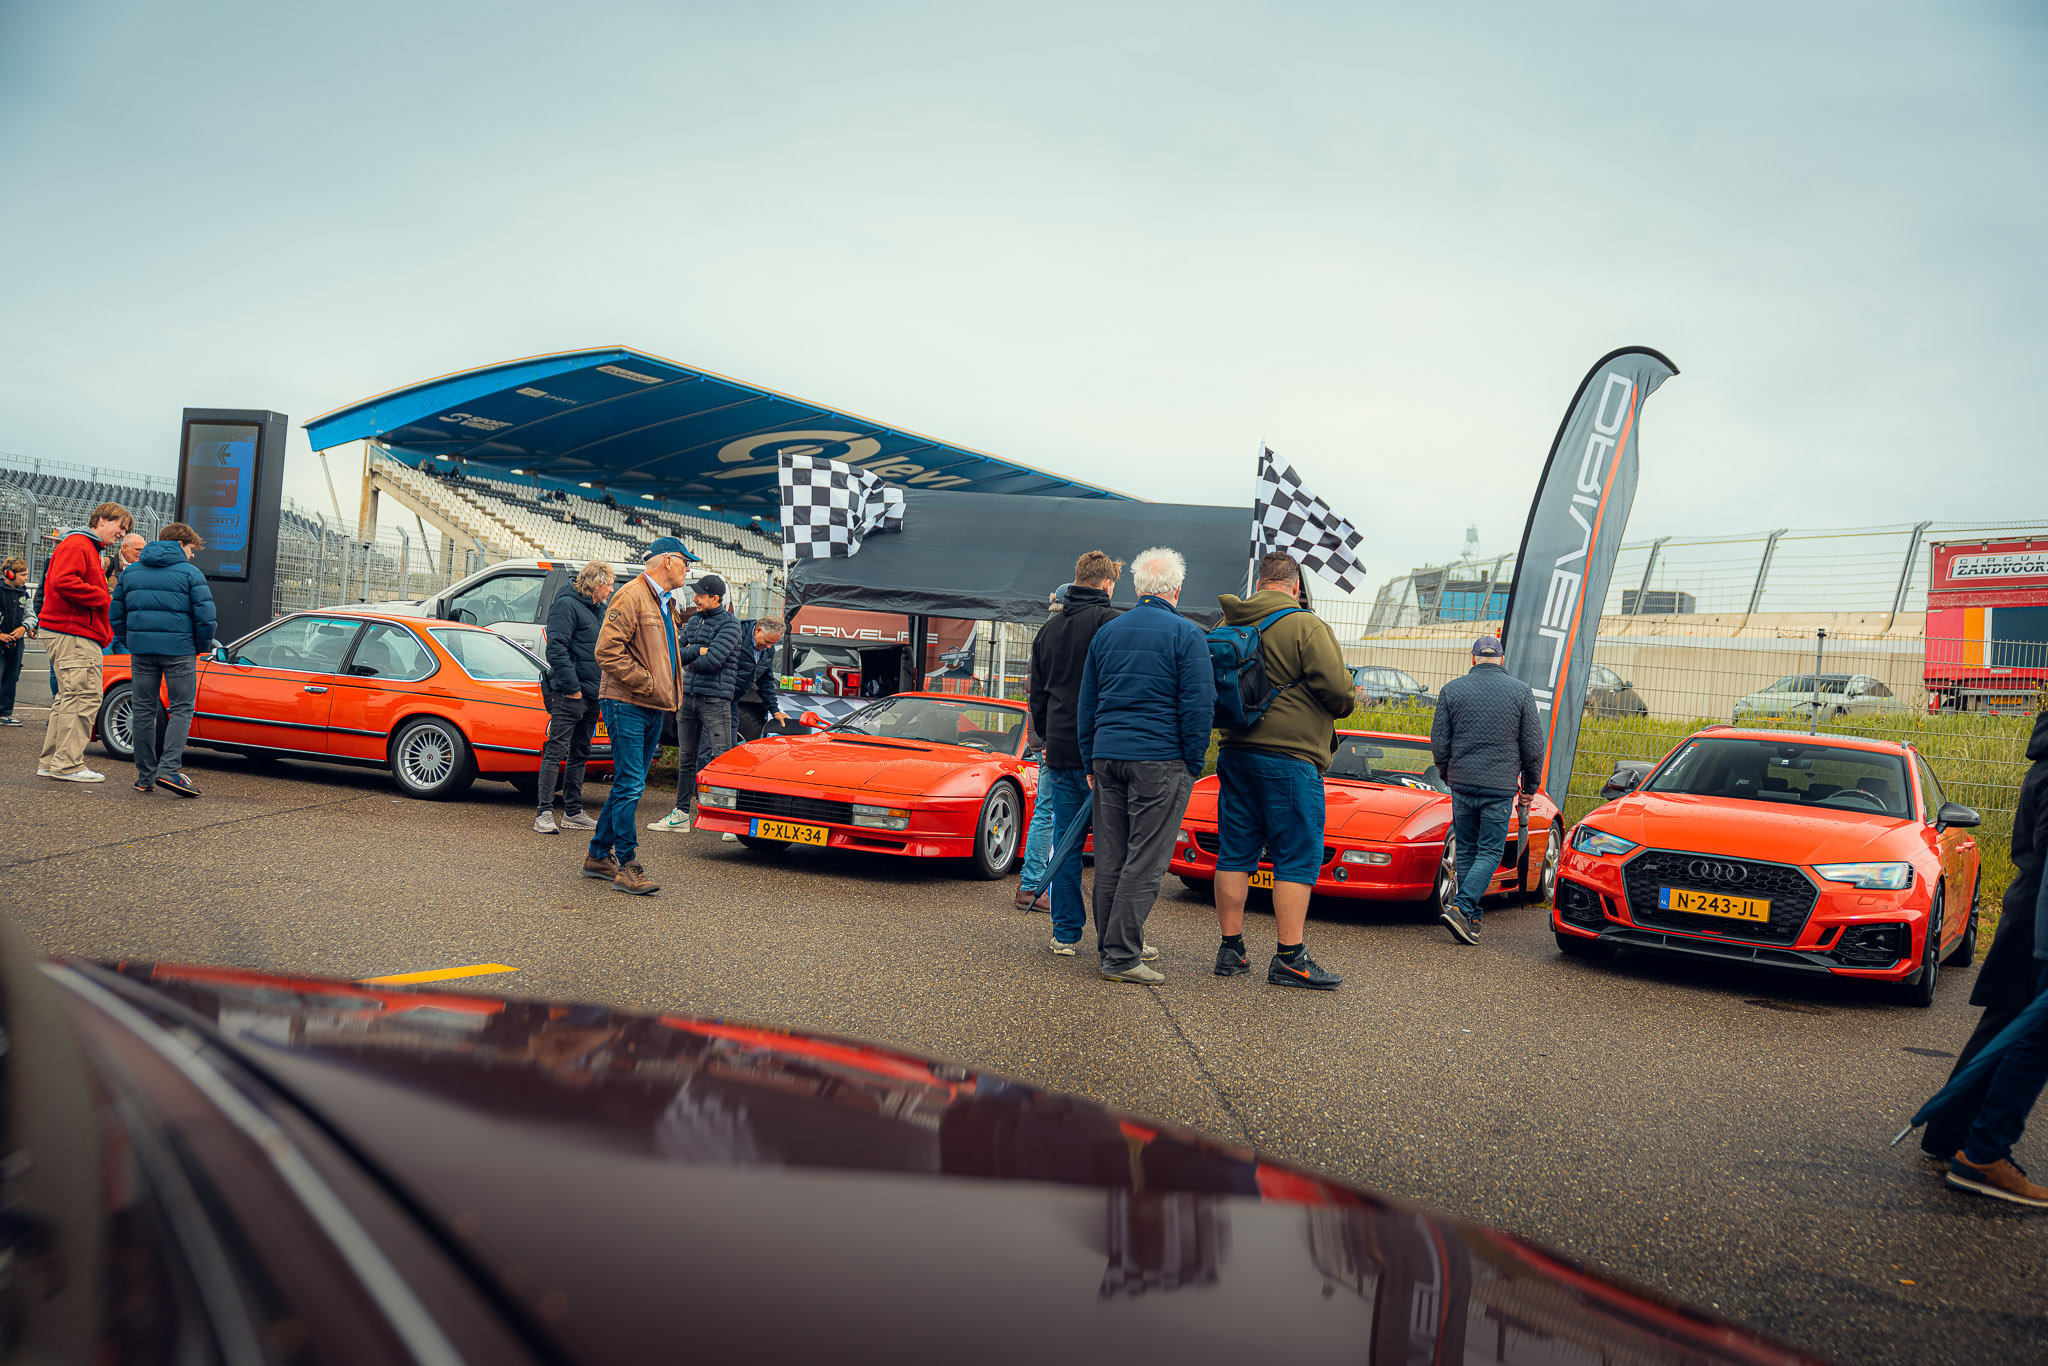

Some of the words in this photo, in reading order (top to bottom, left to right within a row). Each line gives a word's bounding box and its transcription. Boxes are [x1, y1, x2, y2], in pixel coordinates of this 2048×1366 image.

[1960, 555, 2042, 564] CIRCUI
[1957, 562, 2048, 576] ZANDVOOR
[763, 823, 821, 843] 9-XLX-34
[1677, 892, 1759, 918] N-243-JL
